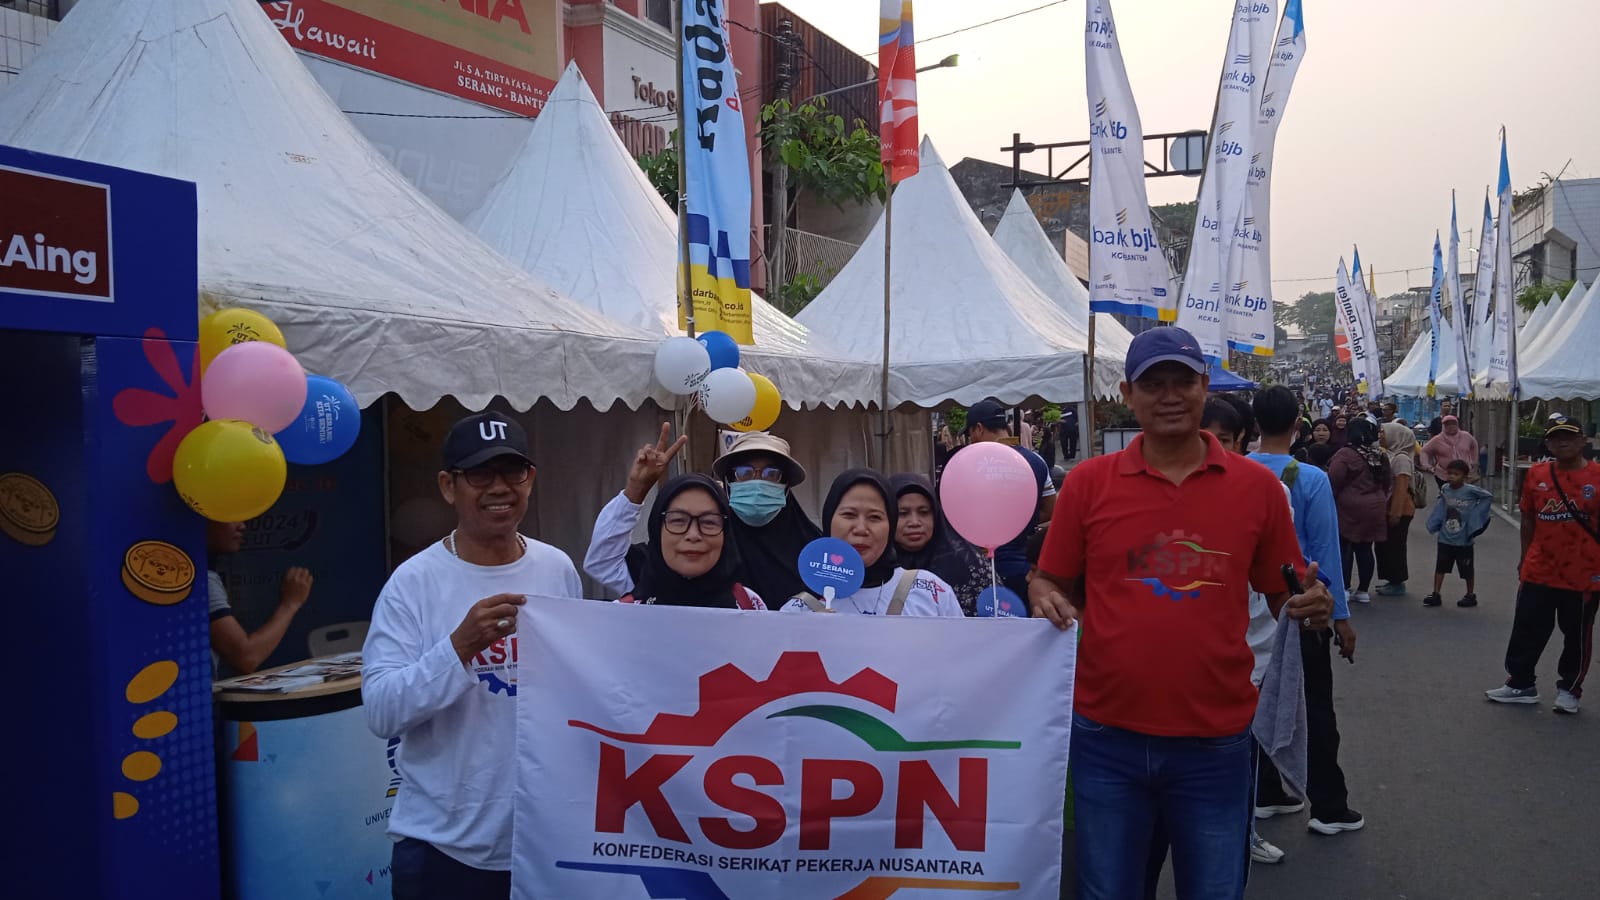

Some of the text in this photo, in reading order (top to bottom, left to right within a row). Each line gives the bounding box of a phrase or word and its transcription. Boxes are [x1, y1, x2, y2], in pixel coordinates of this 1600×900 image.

[1252, 3, 1270, 14] bjb
[271, 1, 377, 59] Hawaii
[1281, 51, 1294, 61] bjb
[458, 75, 503, 98] SERANG
[485, 69, 532, 93] TIRTAYASA
[631, 75, 679, 112] Toko S
[1222, 140, 1243, 155] bjb
[1244, 295, 1267, 311] bjb
[479, 421, 507, 441] UT
[823, 552, 828, 564] I
[1127, 547, 1229, 577] KSPN
[822, 563, 854, 576] SERANG
[595, 741, 988, 852] KSPN
[592, 842, 985, 876] KONFEDERASI SERIKAT PEKERJA NUSANTARA
